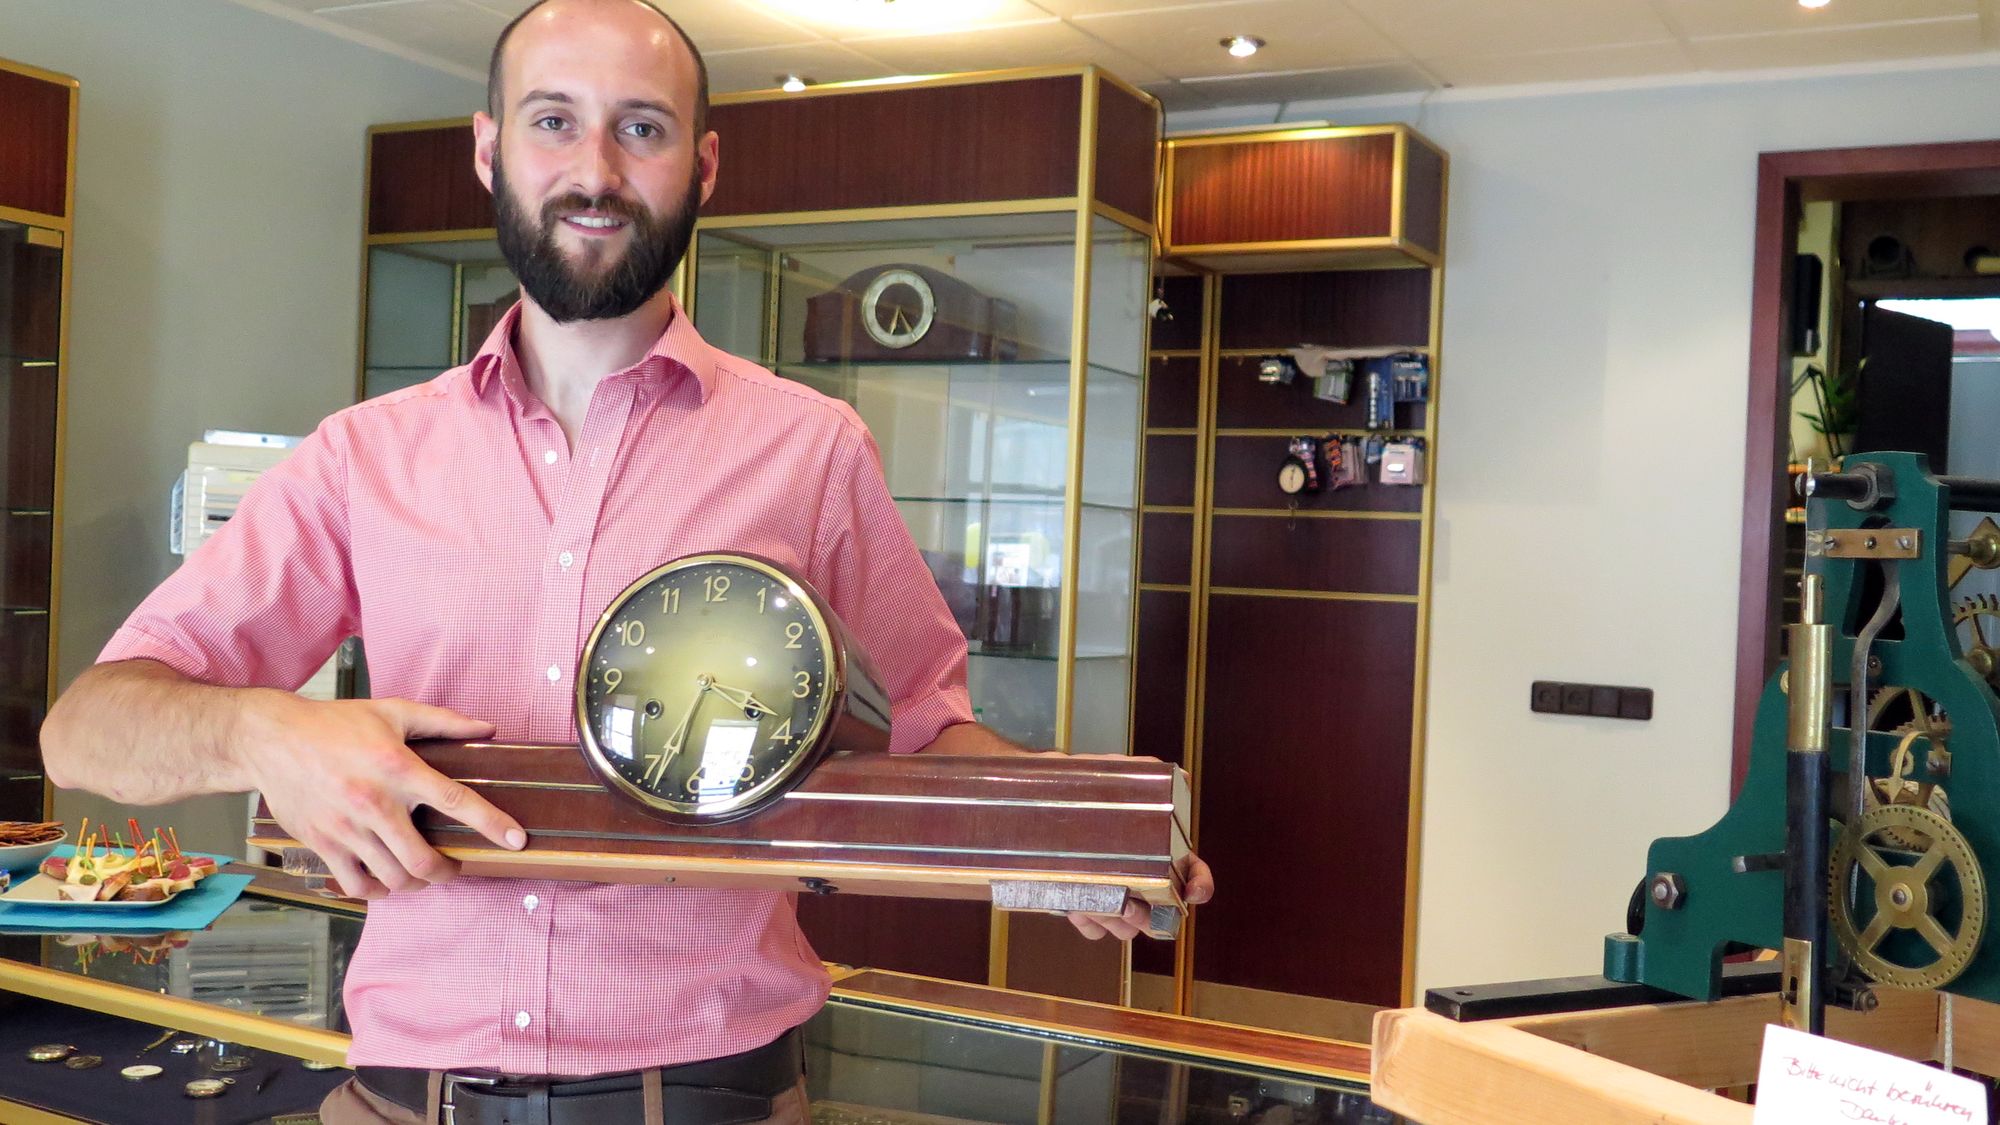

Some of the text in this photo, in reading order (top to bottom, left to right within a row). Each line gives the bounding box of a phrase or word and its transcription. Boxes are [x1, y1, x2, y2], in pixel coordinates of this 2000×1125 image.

[661, 588, 680, 614] 11
[703, 576, 730, 603] 12
[757, 587, 766, 614] 1
[620, 620, 645, 647] 10
[785, 622, 804, 649] 2
[604, 668, 623, 695] 9
[792, 671, 810, 698] 3
[769, 717, 793, 745] 4
[644, 754, 662, 780] 7
[1783, 1056, 1824, 1080] Bitte
[1828, 1074, 1878, 1096] nicht
